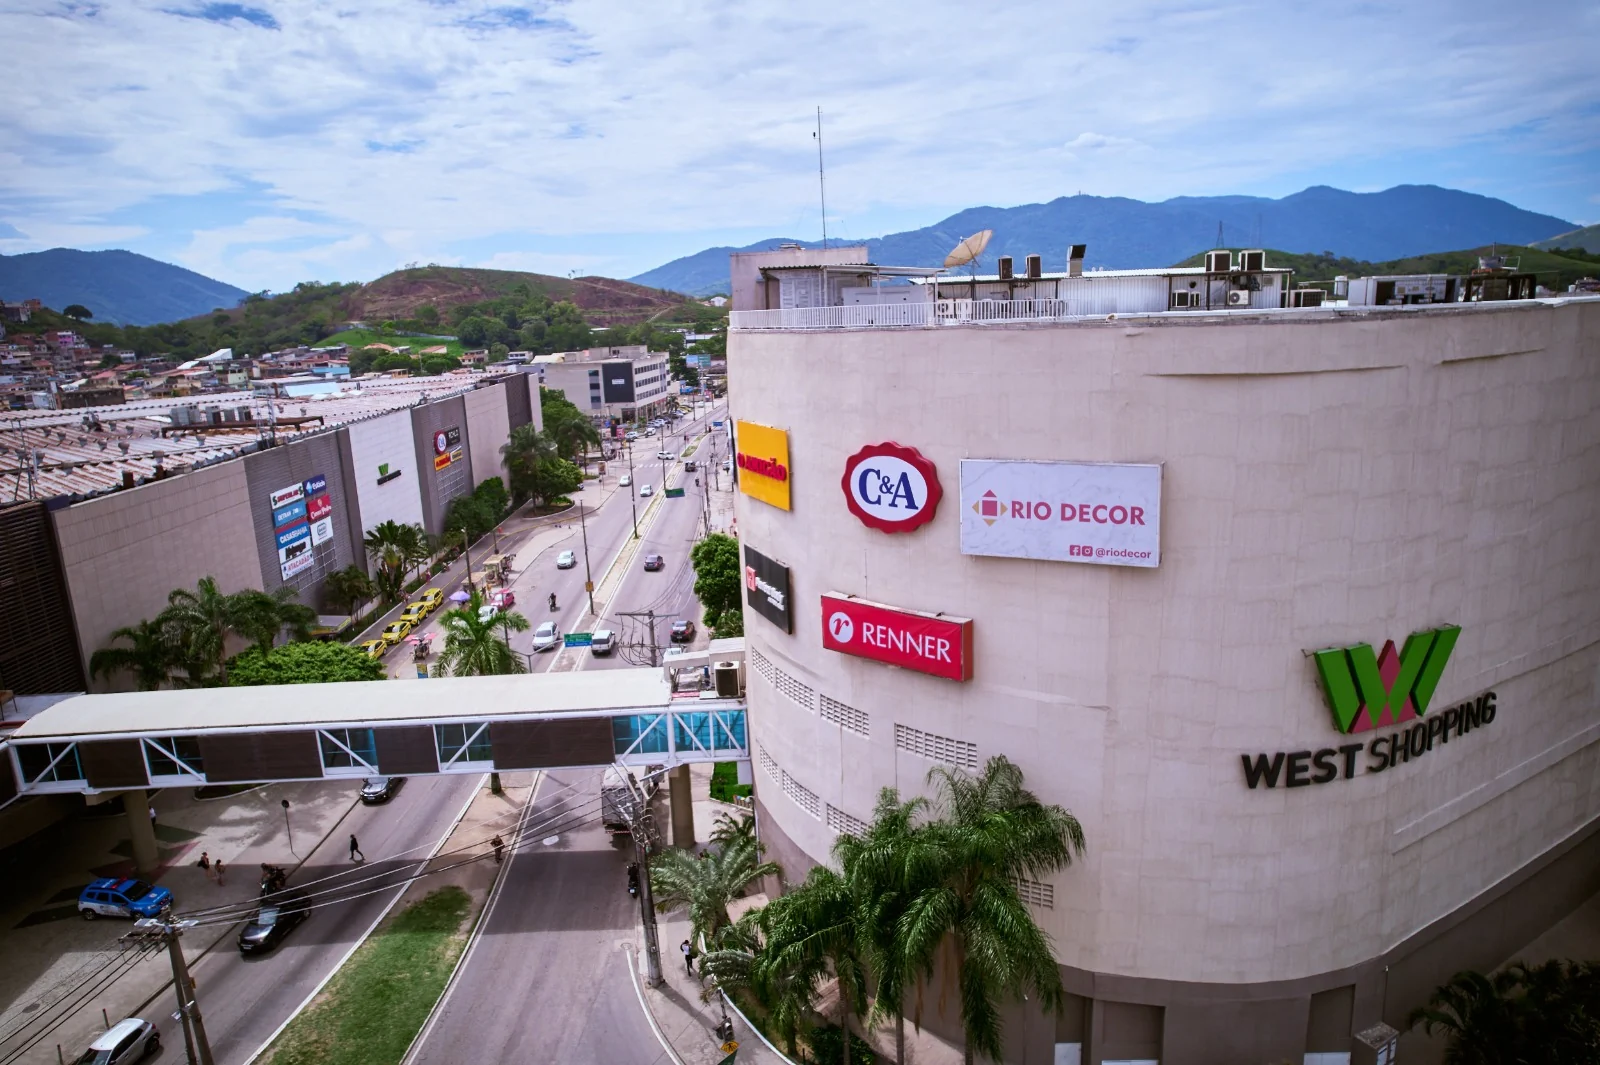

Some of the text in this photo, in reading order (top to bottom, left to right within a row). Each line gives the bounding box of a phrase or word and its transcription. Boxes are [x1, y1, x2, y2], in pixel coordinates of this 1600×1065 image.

[858, 468, 919, 511] C&A
[1011, 500, 1146, 526] RIO DECOR
[1095, 547, 1152, 559] @riodecor
[862, 621, 952, 663] RENNER
[1241, 691, 1498, 790] WEST SHOPPING
